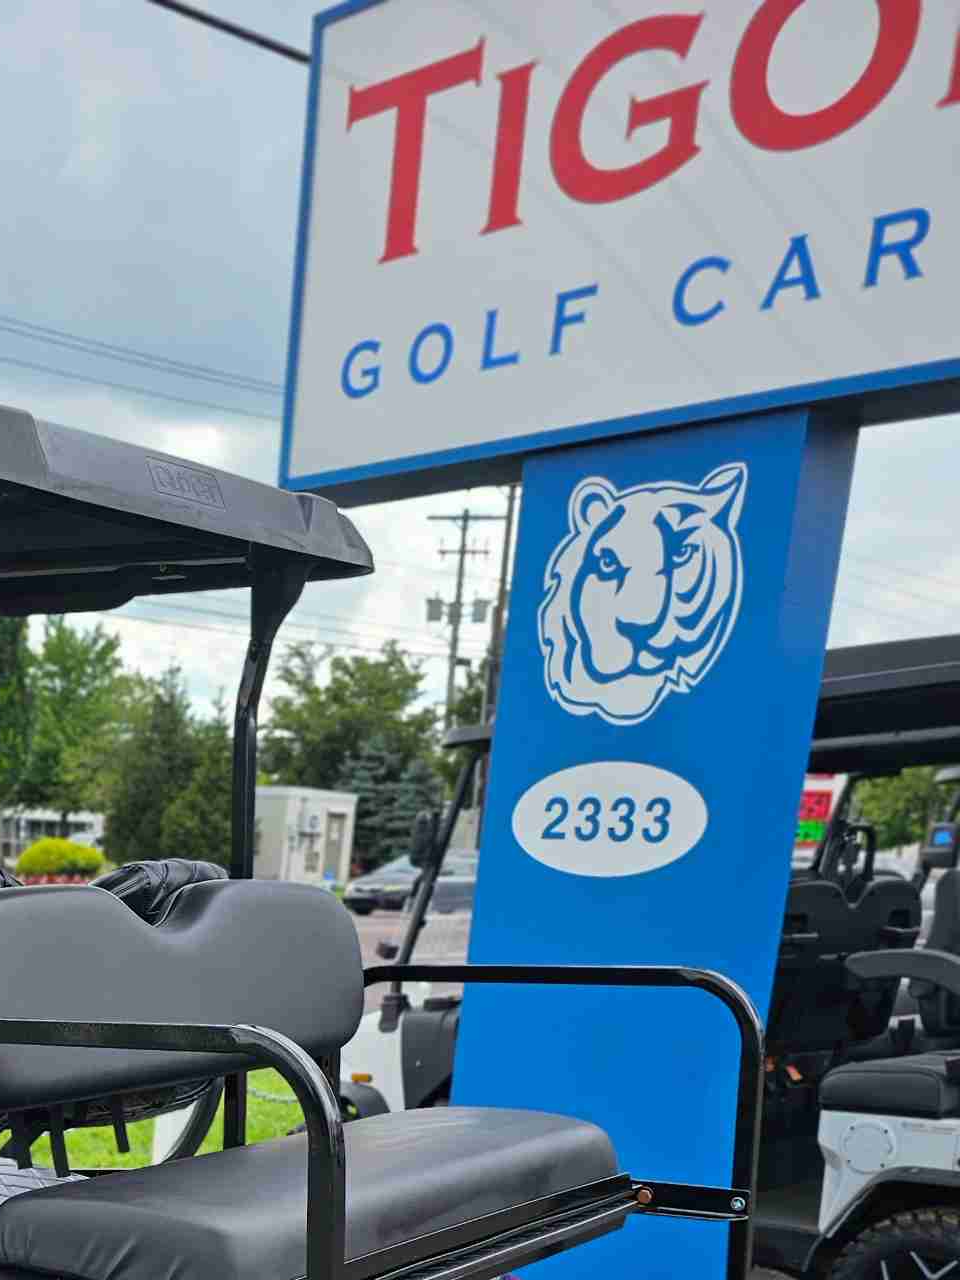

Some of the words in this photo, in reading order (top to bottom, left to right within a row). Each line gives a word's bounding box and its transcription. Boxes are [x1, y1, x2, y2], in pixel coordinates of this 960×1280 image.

[346, 0, 960, 264] TIGO
[340, 284, 599, 399] GOLF
[671, 207, 930, 327] CAR
[540, 796, 672, 844] 2333
